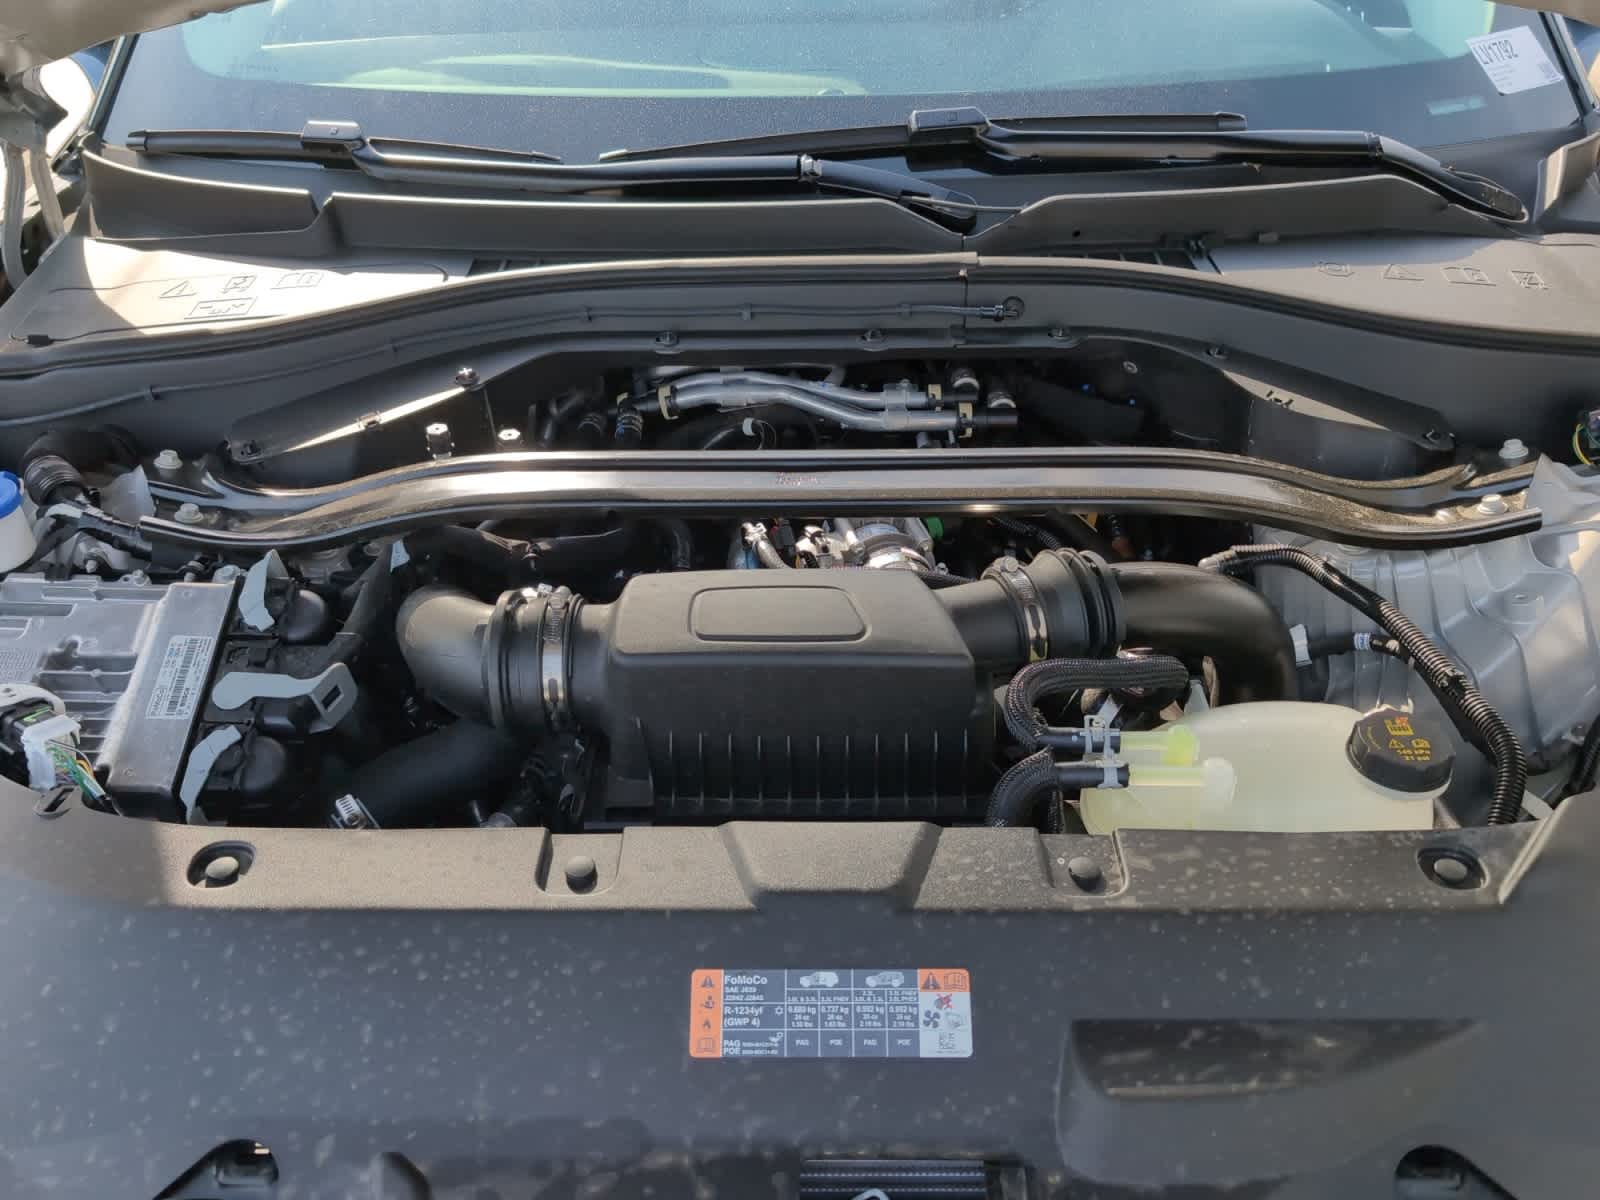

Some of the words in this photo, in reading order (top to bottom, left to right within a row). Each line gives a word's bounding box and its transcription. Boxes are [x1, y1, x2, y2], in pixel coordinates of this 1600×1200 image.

[724, 975, 768, 985] FoMoCo
[724, 1006, 763, 1016] R-1234yf
[808, 1005, 817, 1015] kg
[840, 1005, 849, 1015] kg
[876, 1005, 885, 1015] kg
[909, 1005, 918, 1015] kg
[724, 1017, 749, 1027] (GWP
[751, 1017, 760, 1027] 4)
[724, 1039, 741, 1047] PAG
[724, 1047, 741, 1055] POE
